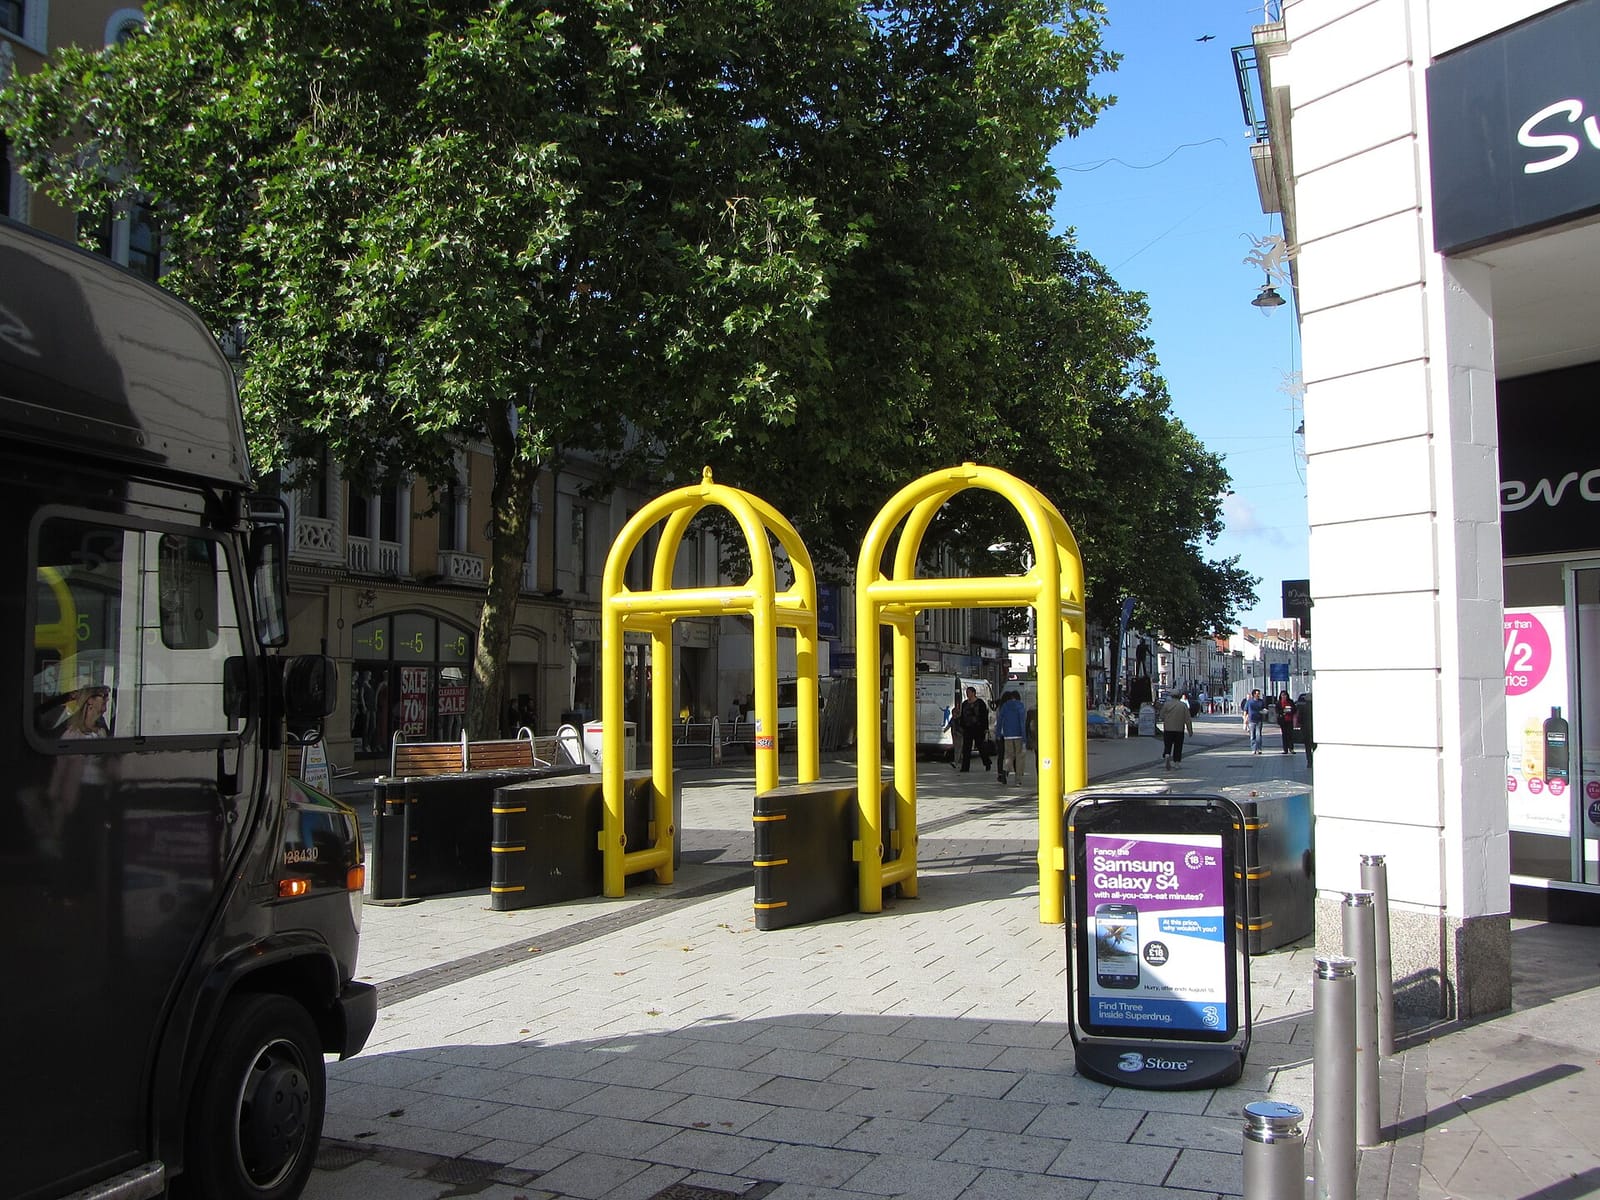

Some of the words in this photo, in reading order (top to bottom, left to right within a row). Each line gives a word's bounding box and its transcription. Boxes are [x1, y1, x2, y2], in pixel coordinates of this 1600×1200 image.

[1514, 620, 1532, 629] than
[402, 670, 427, 694] SALE
[438, 688, 465, 696] CLEARANCE
[403, 699, 424, 721] 70%
[438, 696, 465, 713] SALE
[403, 722, 423, 734] OFF
[283, 847, 318, 865] 128430
[1093, 848, 1115, 857] Fancy
[1116, 848, 1129, 856] the
[1093, 856, 1175, 876] Samsung
[1189, 855, 1199, 864] 18
[1093, 873, 1152, 892] Galaxy
[1155, 874, 1179, 890] S4
[1094, 891, 1110, 899] with
[1111, 892, 1168, 900] all-you-can-eat
[1169, 893, 1204, 901] minutes?
[1098, 1001, 1117, 1010] Find
[1118, 1002, 1143, 1011] Three
[1099, 1010, 1124, 1019] inside
[1125, 1011, 1173, 1024] Superdrug.
